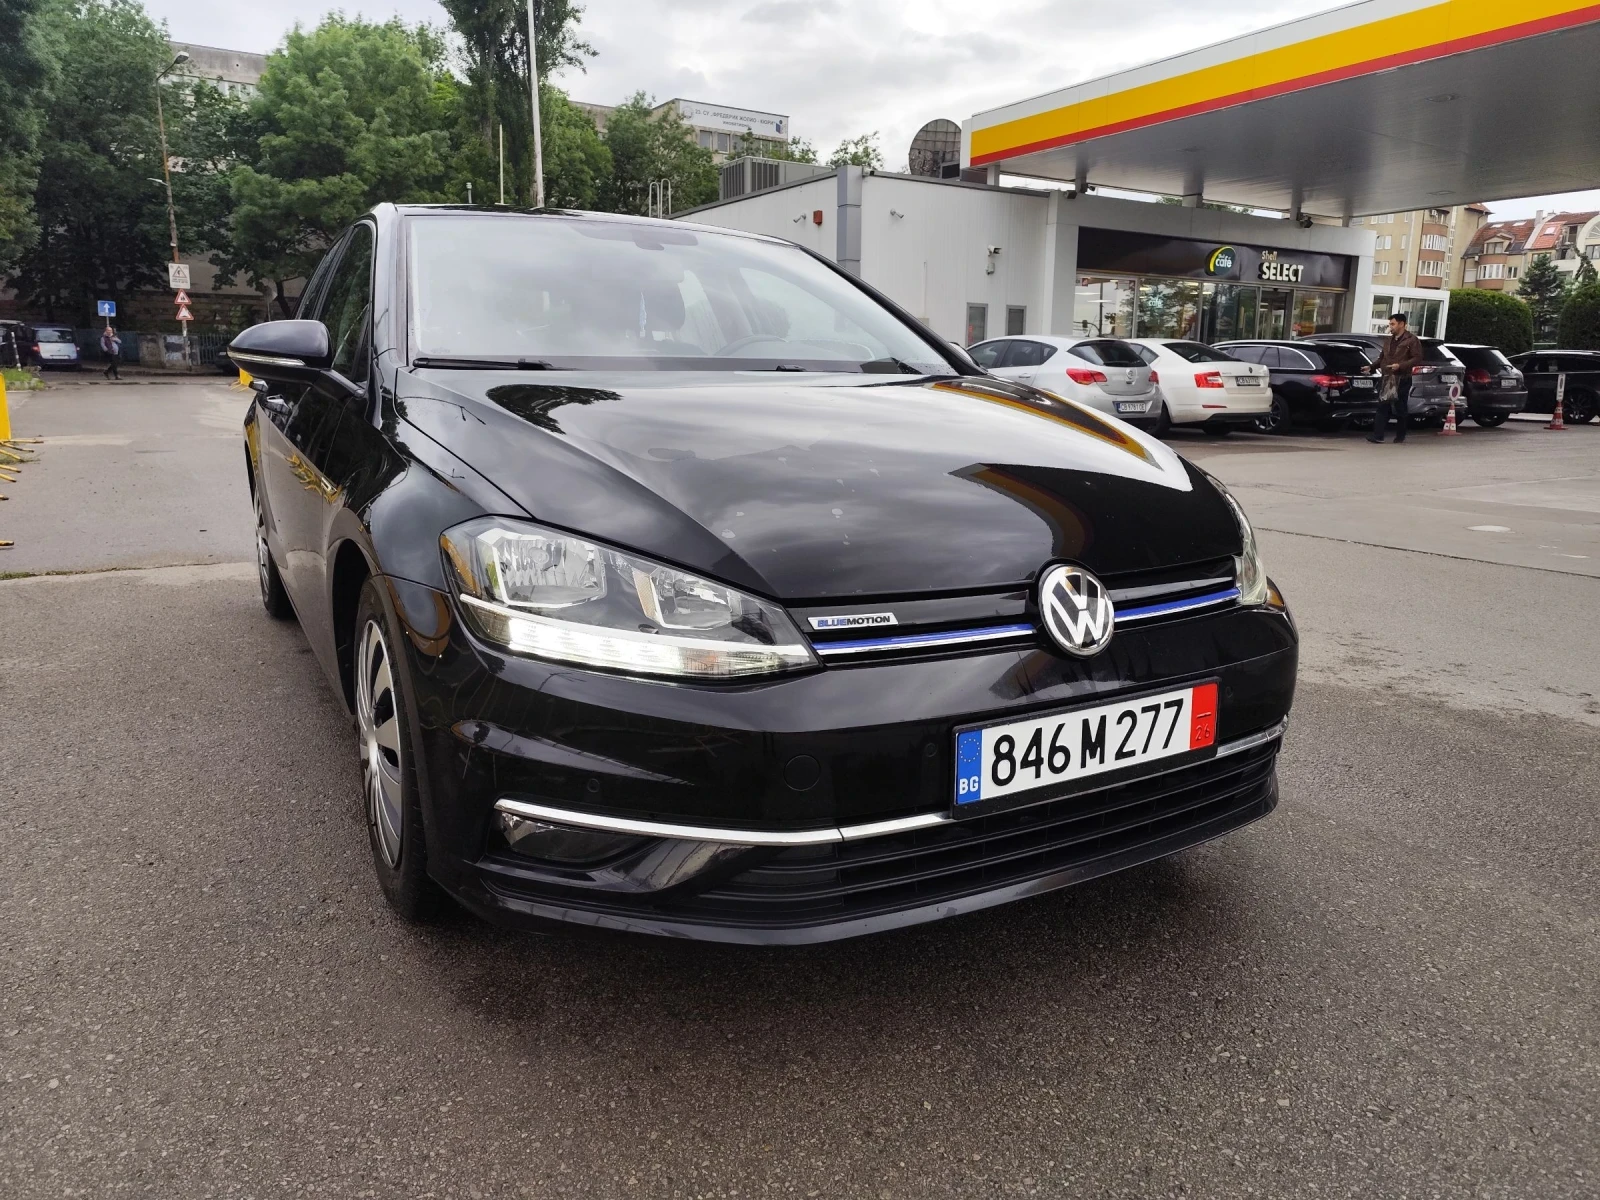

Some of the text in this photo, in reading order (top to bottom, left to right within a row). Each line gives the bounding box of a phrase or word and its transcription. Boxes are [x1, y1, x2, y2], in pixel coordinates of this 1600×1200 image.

[1215, 255, 1232, 268] café
[1261, 250, 1278, 261] Shell
[1262, 262, 1304, 282] SELECT
[817, 614, 891, 628] BLUEMOTION
[1195, 723, 1211, 741] 26
[959, 775, 979, 795] BG
